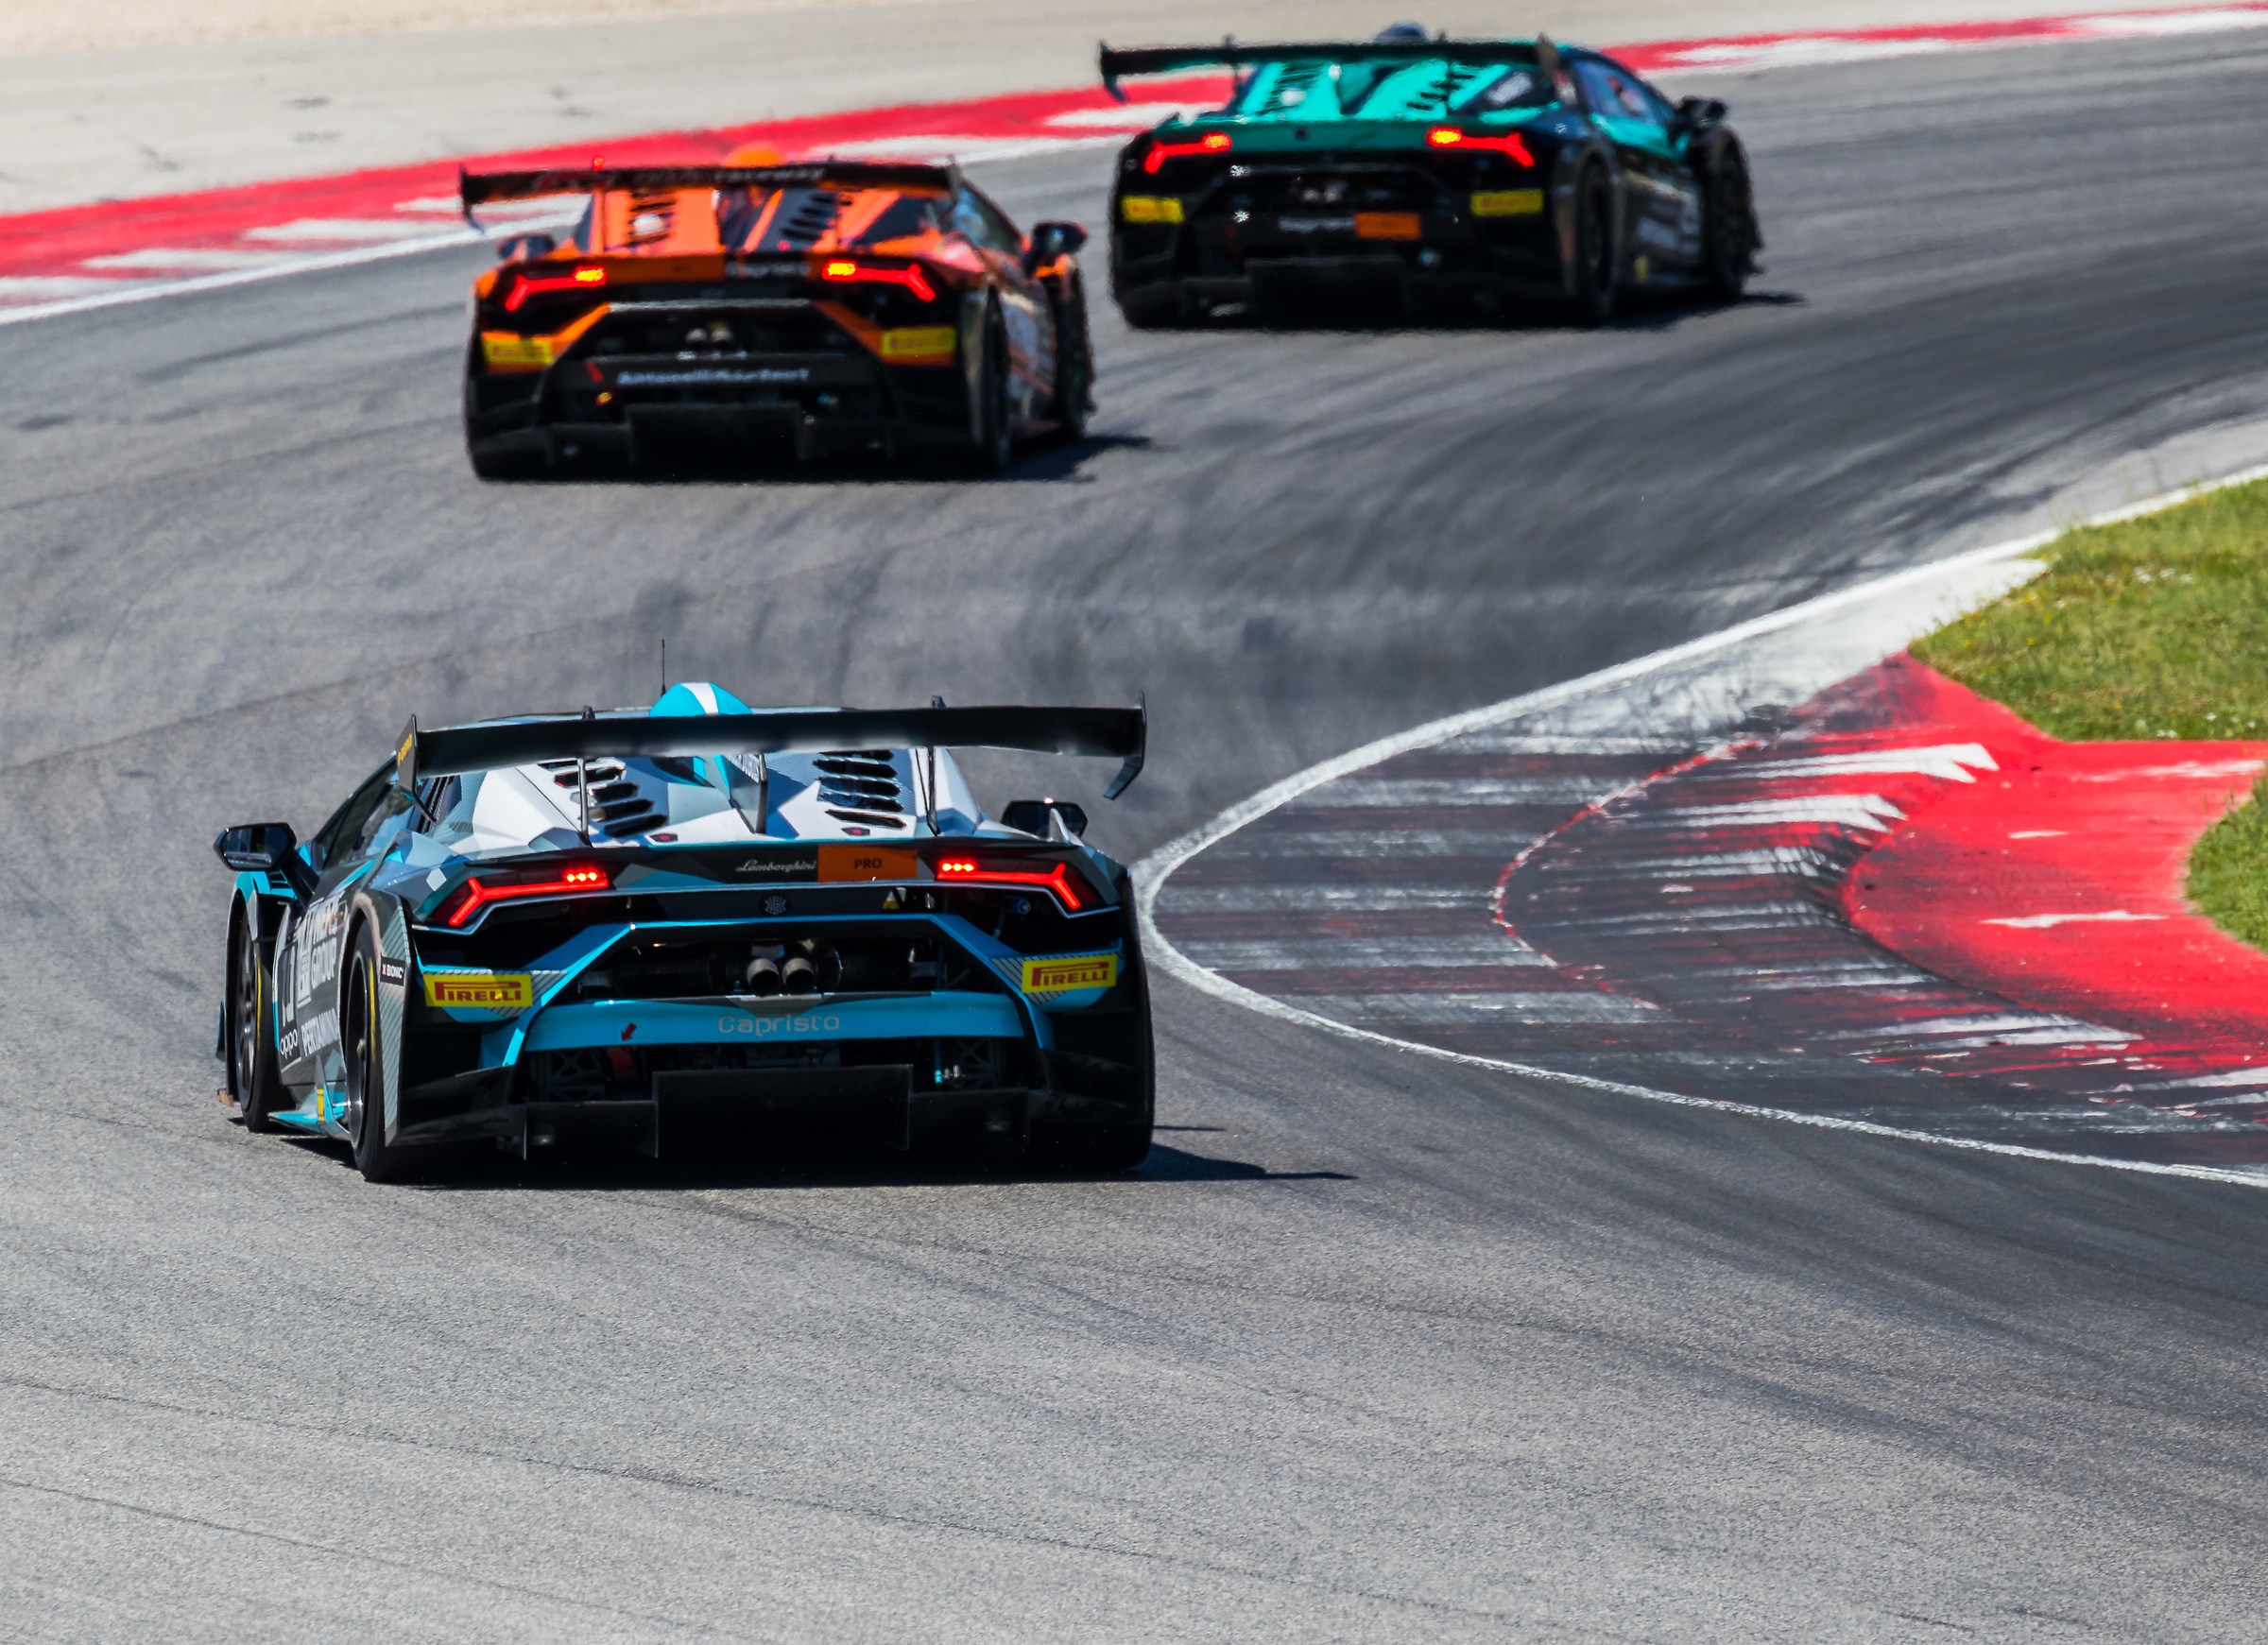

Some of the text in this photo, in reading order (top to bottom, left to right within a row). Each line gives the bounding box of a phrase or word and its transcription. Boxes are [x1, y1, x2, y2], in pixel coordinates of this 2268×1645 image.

[735, 859, 817, 873] Lamborghini
[854, 858, 882, 869] PRO
[1031, 962, 1109, 986] PIRELLI
[435, 981, 522, 1002] PIRELLI
[718, 1014, 840, 1037] Capristo
[280, 1028, 299, 1059] oppo
